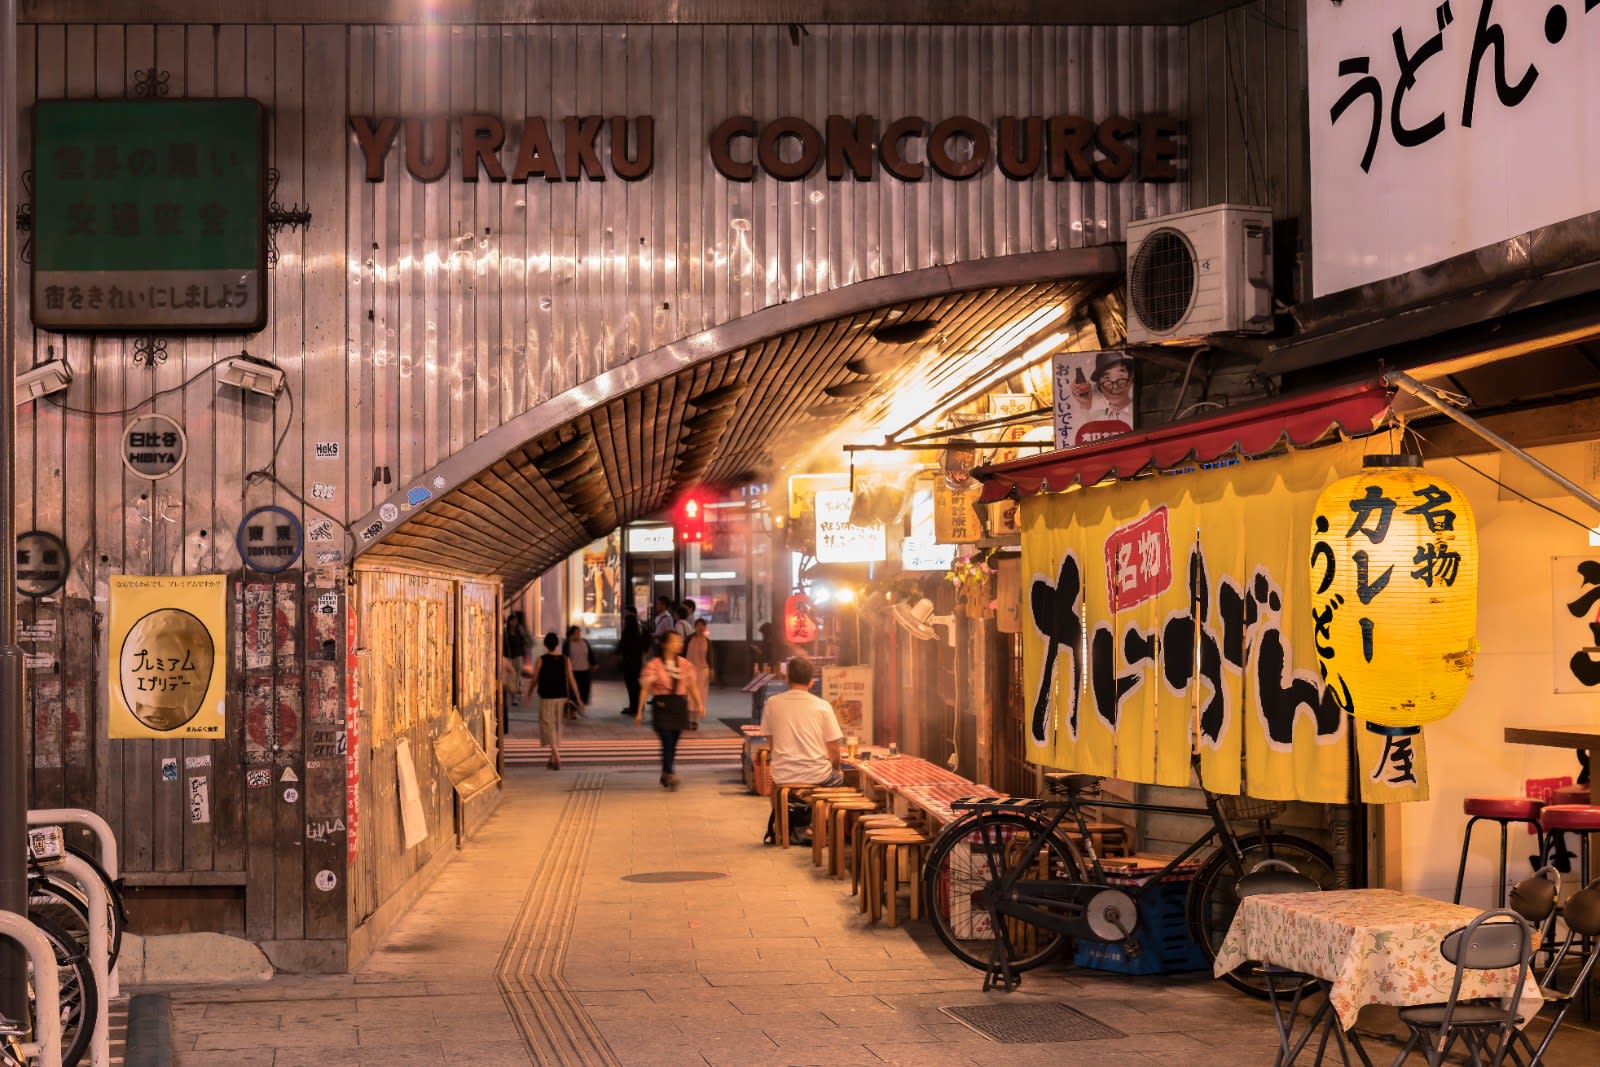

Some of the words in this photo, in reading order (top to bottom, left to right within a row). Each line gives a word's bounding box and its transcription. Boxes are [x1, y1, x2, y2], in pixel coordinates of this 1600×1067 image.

[350, 114, 654, 184] YURAKU
[710, 114, 1189, 183] CONCOURSE
[129, 432, 178, 448] 日比谷
[129, 453, 177, 465] HIBIYA
[1116, 530, 1161, 592] 名物
[1404, 484, 1461, 587] 名物
[1345, 485, 1398, 663] カレー
[1311, 515, 1355, 714] うどん
[131, 649, 196, 673] プレミアム
[1031, 550, 1341, 743] カレーうどん
[137, 675, 192, 692] エブリデー
[1373, 735, 1417, 783] 屋
